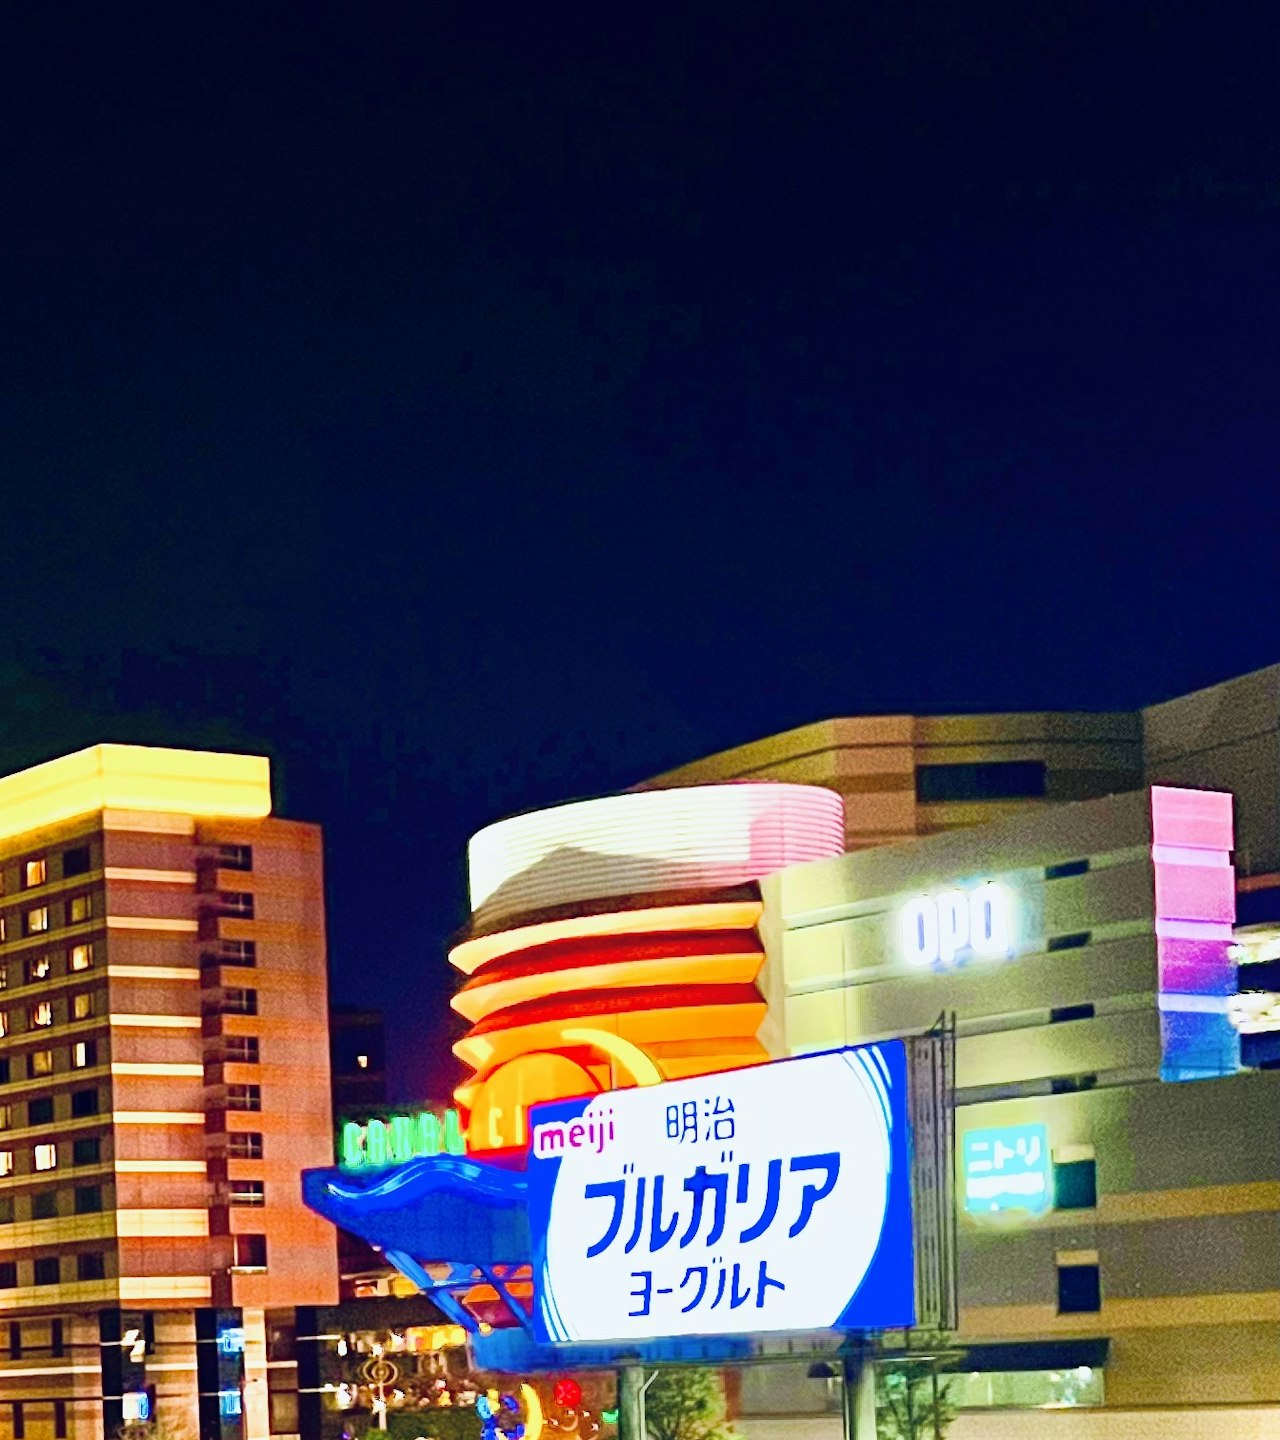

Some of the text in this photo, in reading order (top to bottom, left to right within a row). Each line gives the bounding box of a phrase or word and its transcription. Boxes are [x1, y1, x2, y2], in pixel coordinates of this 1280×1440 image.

[343, 1109, 466, 1168] CANAL
[540, 1109, 614, 1153] meiji
[666, 1096, 735, 1143] 明治
[968, 1135, 1041, 1172] ニトリ
[584, 1151, 840, 1258] ブルガリア
[628, 1256, 785, 1316] ヨーグルト
